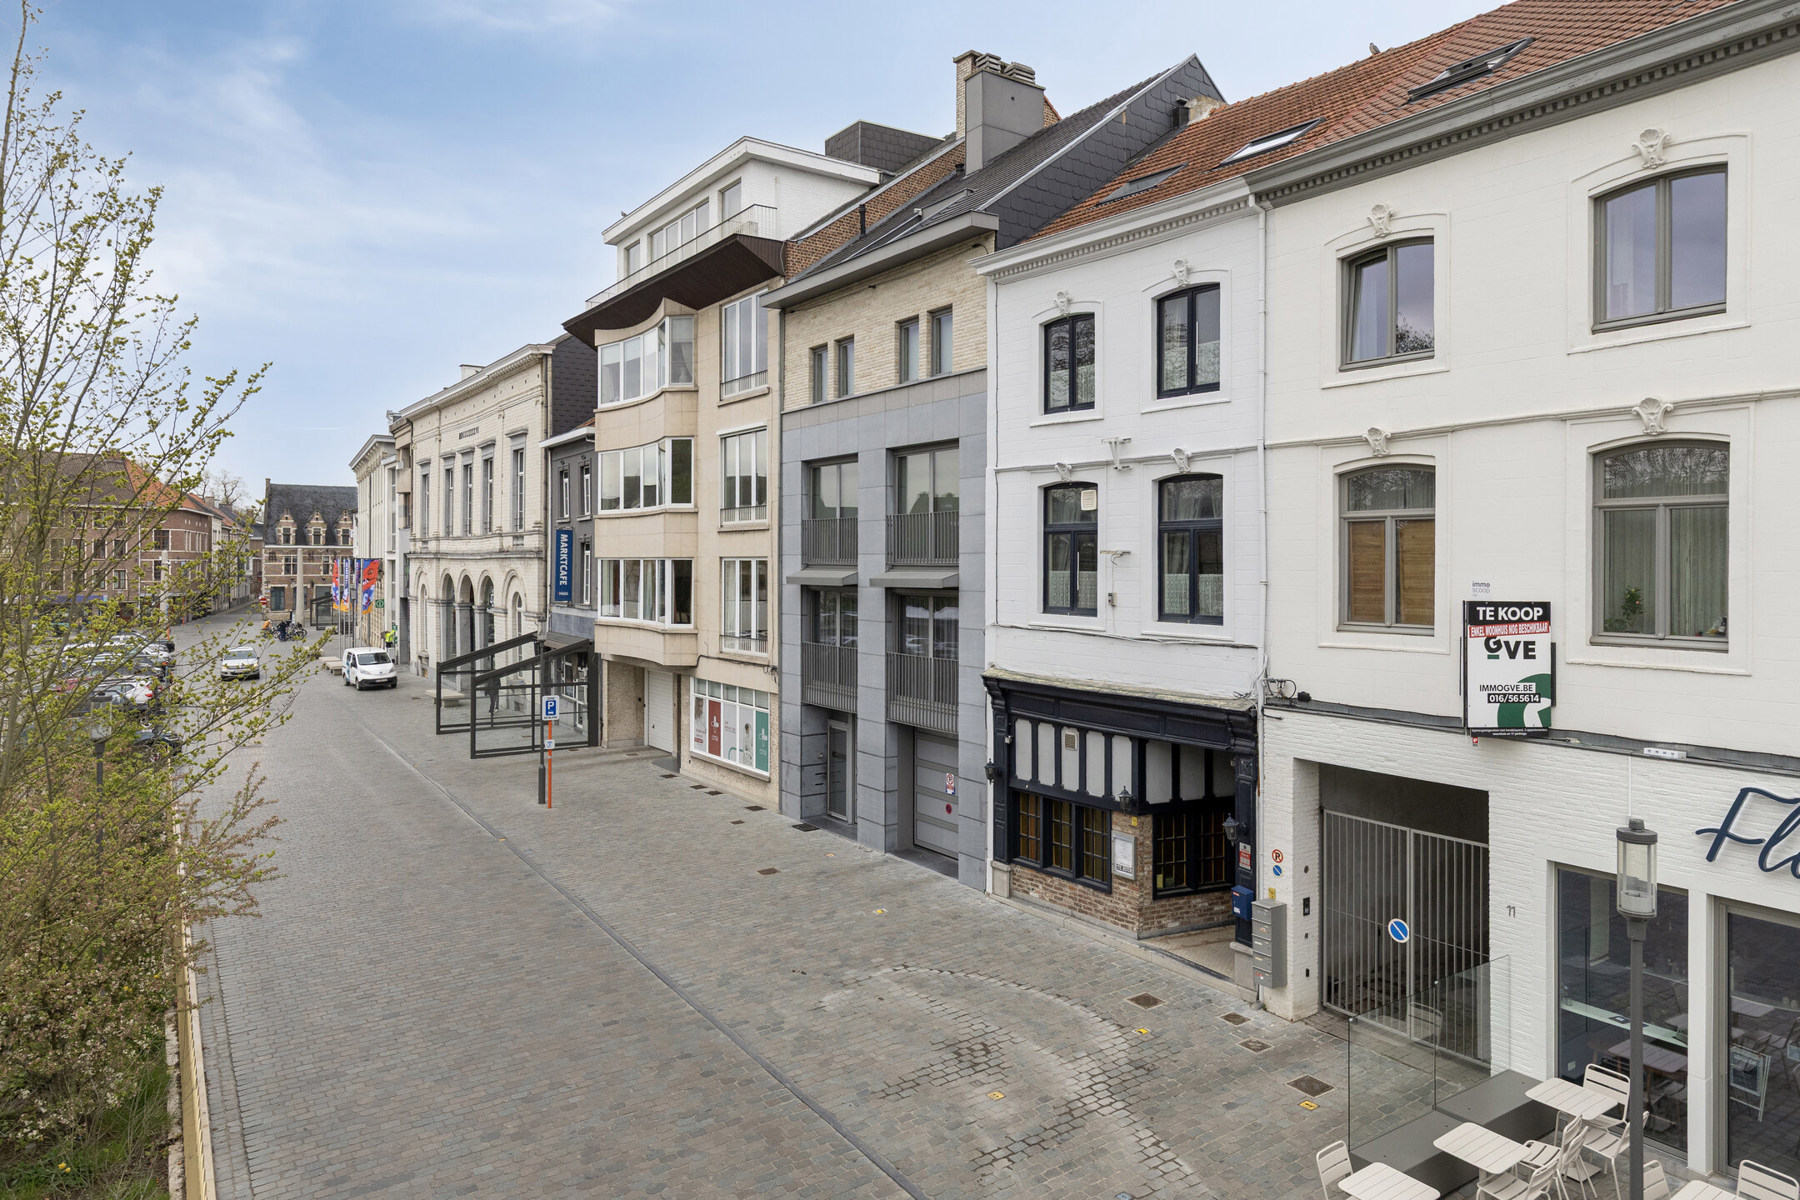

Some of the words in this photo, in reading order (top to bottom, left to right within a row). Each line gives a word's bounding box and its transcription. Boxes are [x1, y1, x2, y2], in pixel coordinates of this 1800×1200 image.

[559, 533, 569, 586] MARKTCAFE
[1476, 606, 1495, 620] TE
[1498, 606, 1543, 621] KOOP
[1470, 626, 1485, 637] ENKEL
[1485, 625, 1508, 636] WOONHUIS
[1508, 624, 1518, 634] NOG
[1518, 622, 1549, 634] BESCHIKBAAR
[1484, 636, 1536, 660] GVE
[1479, 684, 1533, 692] IMMOGVE.BE
[547, 701, 555, 710] P
[1695, 787, 1800, 879] Fl
